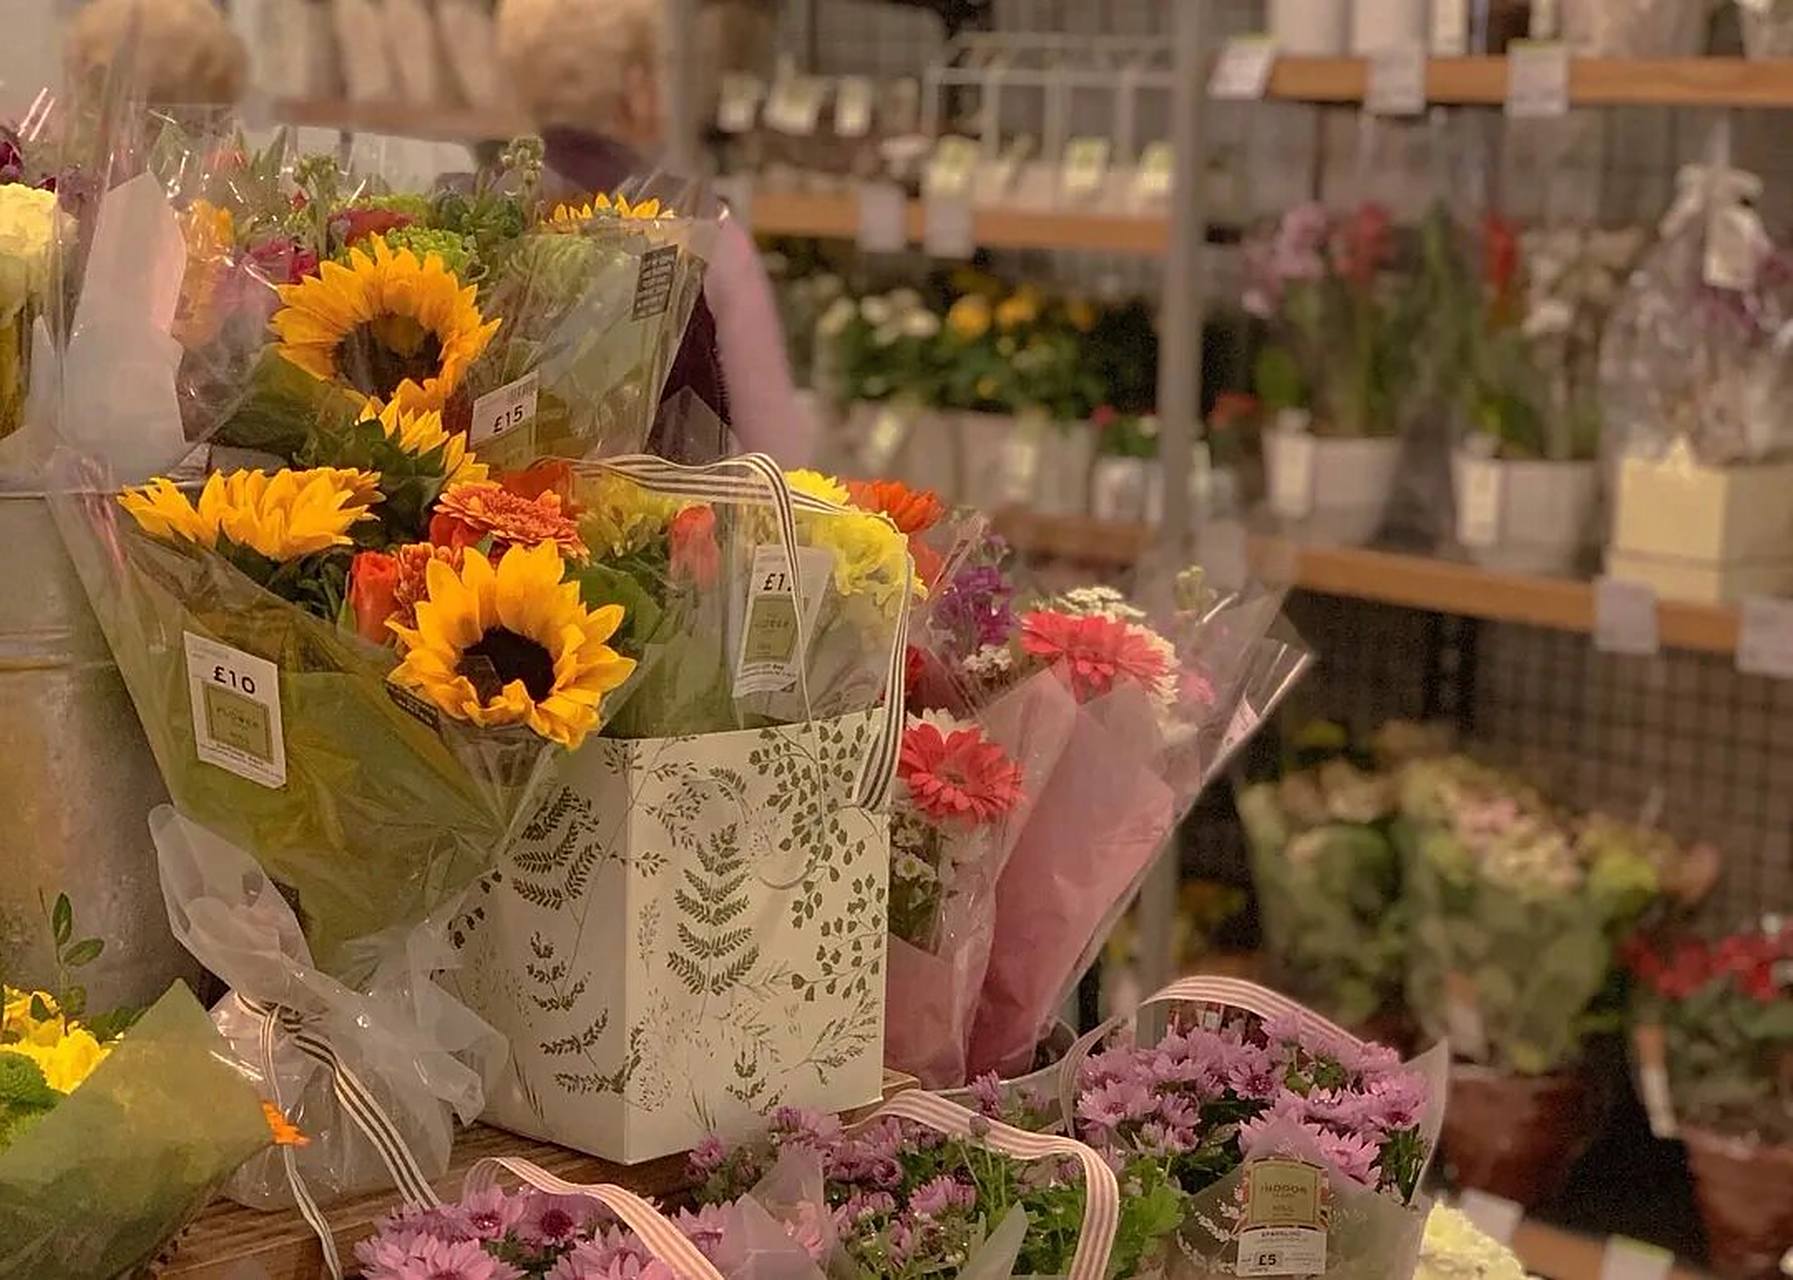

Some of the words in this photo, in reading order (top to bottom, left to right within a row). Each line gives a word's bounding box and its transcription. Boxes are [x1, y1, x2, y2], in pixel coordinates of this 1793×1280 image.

[493, 404, 524, 433] £15
[762, 572, 803, 592] £1
[213, 665, 256, 695] £10
[1258, 1254, 1278, 1266] £5
